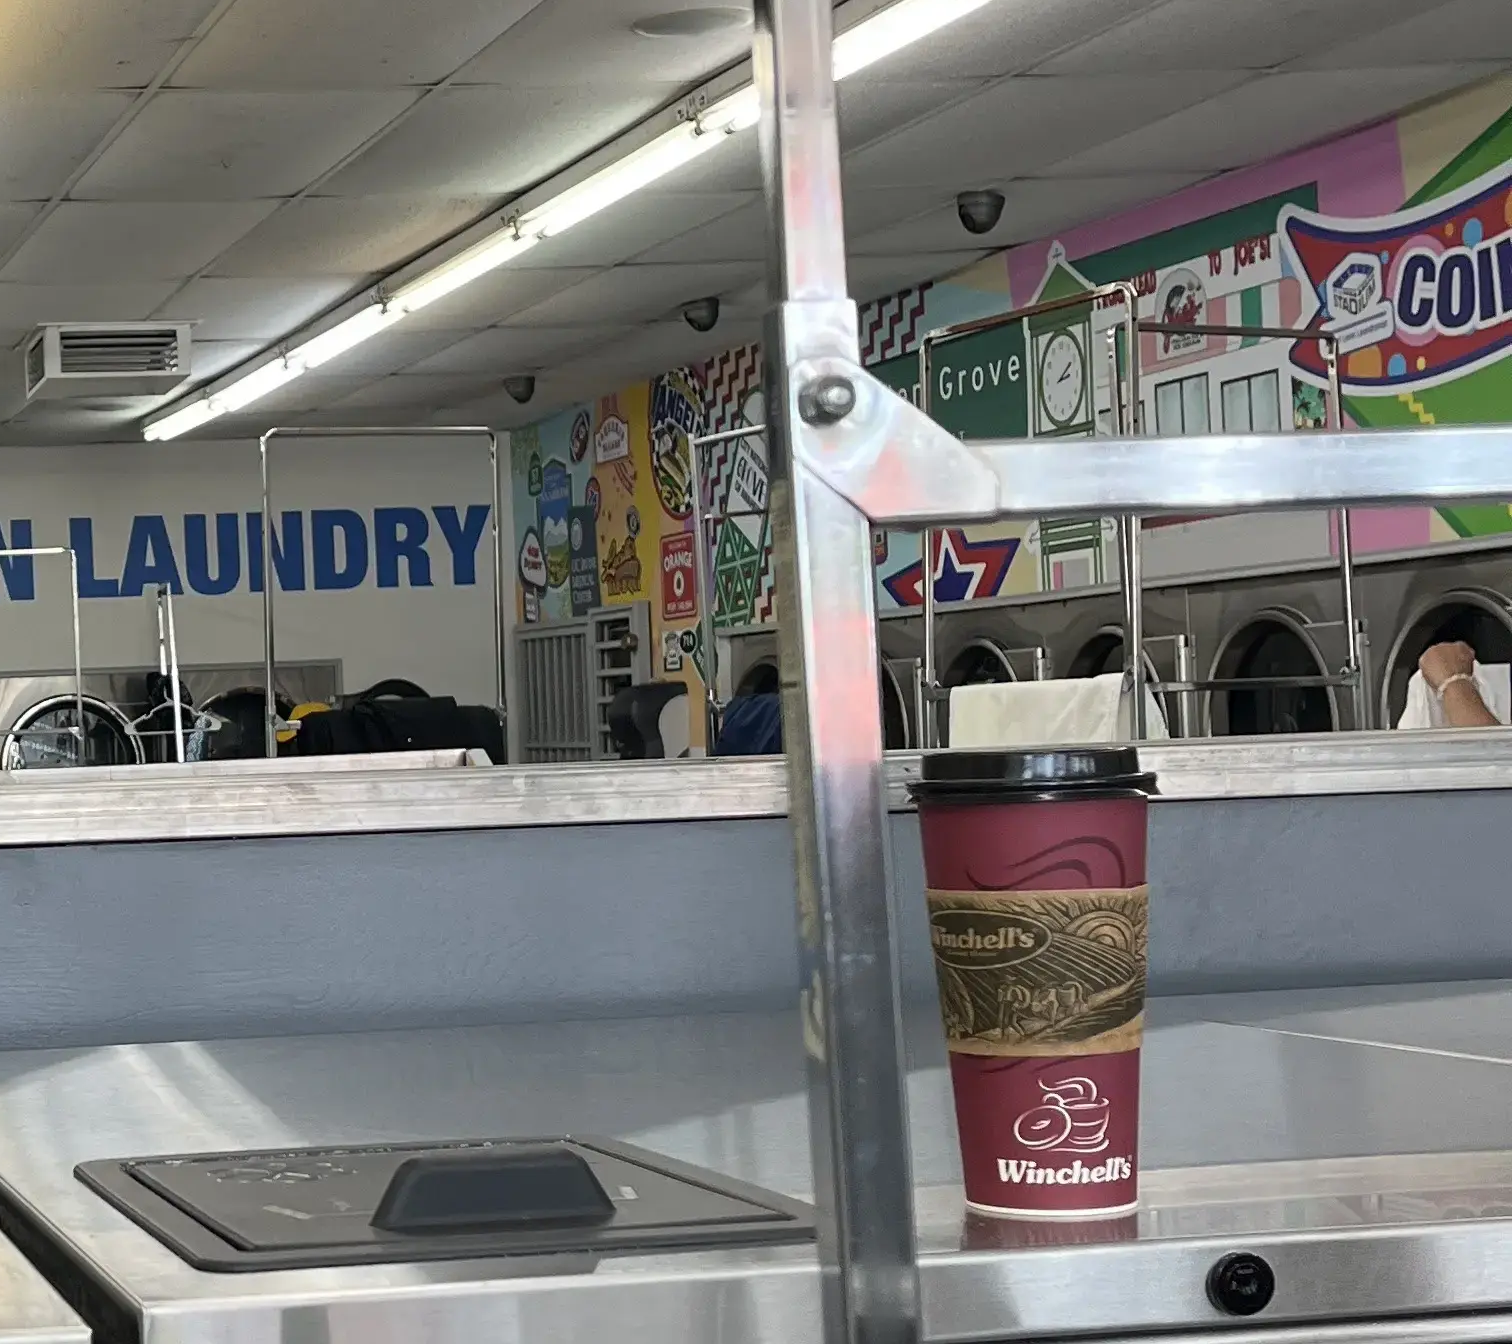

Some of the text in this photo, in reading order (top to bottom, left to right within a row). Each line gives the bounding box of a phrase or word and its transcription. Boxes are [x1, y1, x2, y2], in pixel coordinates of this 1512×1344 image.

[939, 354, 1021, 401] Grove
[68, 503, 491, 600] LAUNDRY
[663, 551, 693, 572] ORANGE
[996, 1155, 1132, 1185] Winchell's
